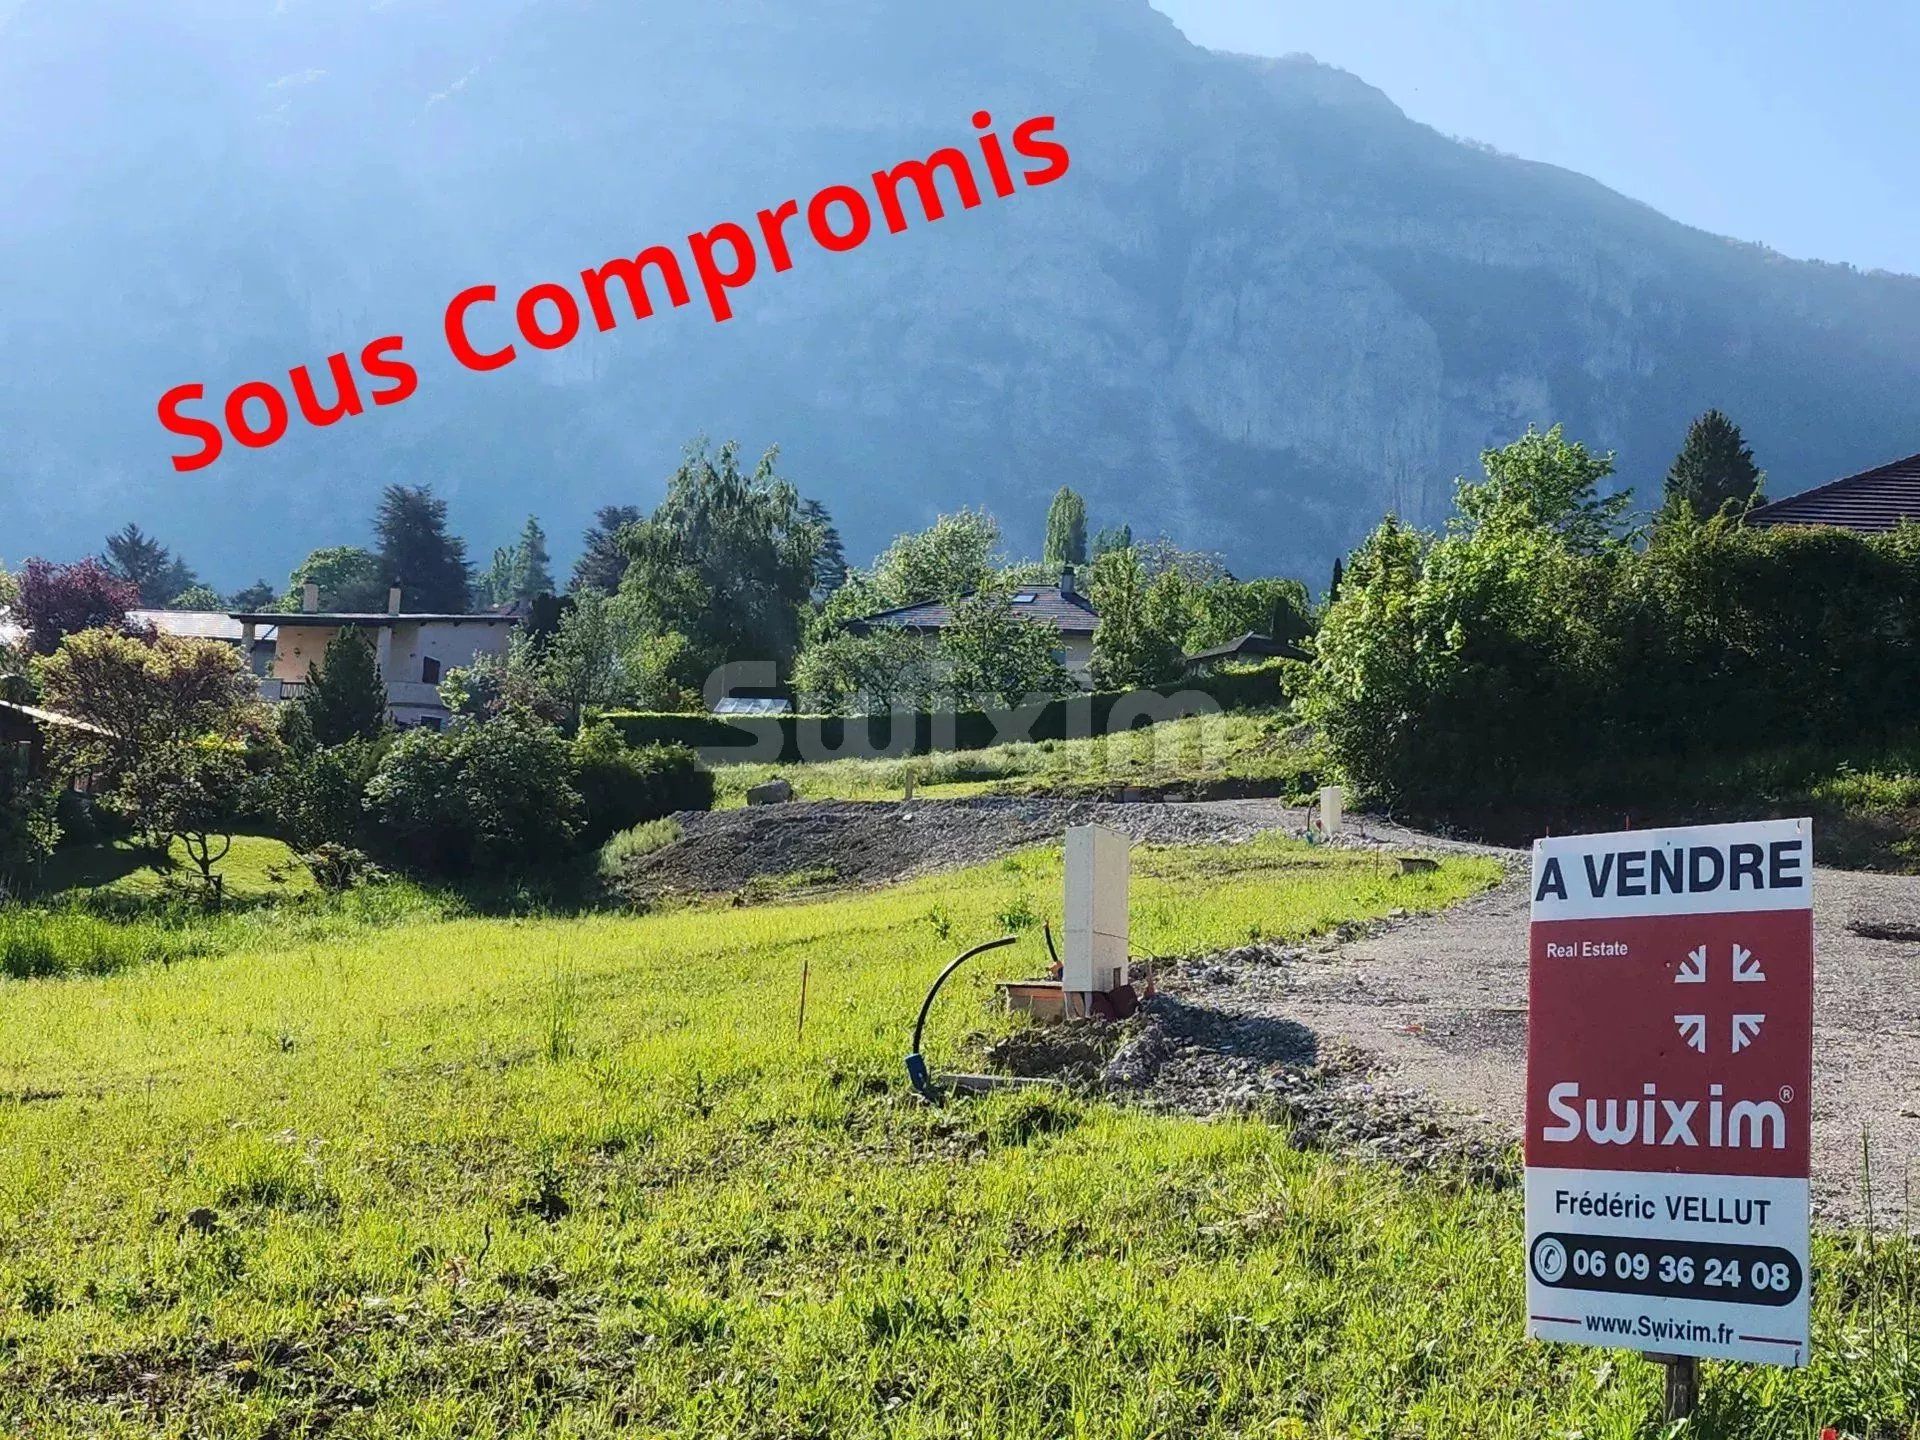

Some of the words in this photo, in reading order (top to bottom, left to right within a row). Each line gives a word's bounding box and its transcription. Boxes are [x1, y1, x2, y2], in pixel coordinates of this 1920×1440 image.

[1535, 857, 1568, 901] A
[1583, 840, 1803, 898] VENDRE
[1546, 942, 1578, 958] Real
[1582, 941, 1628, 957] Estate
[1556, 1190, 1656, 1219] Frédéric
[1665, 1195, 1771, 1226] VELLUT
[1573, 1250, 1606, 1277] 06
[1615, 1252, 1650, 1281] 09
[1658, 1255, 1695, 1285] 36
[1704, 1258, 1741, 1288] 24
[1751, 1261, 1790, 1292] 08
[1585, 1314, 1734, 1345] www.Swixim.fr
